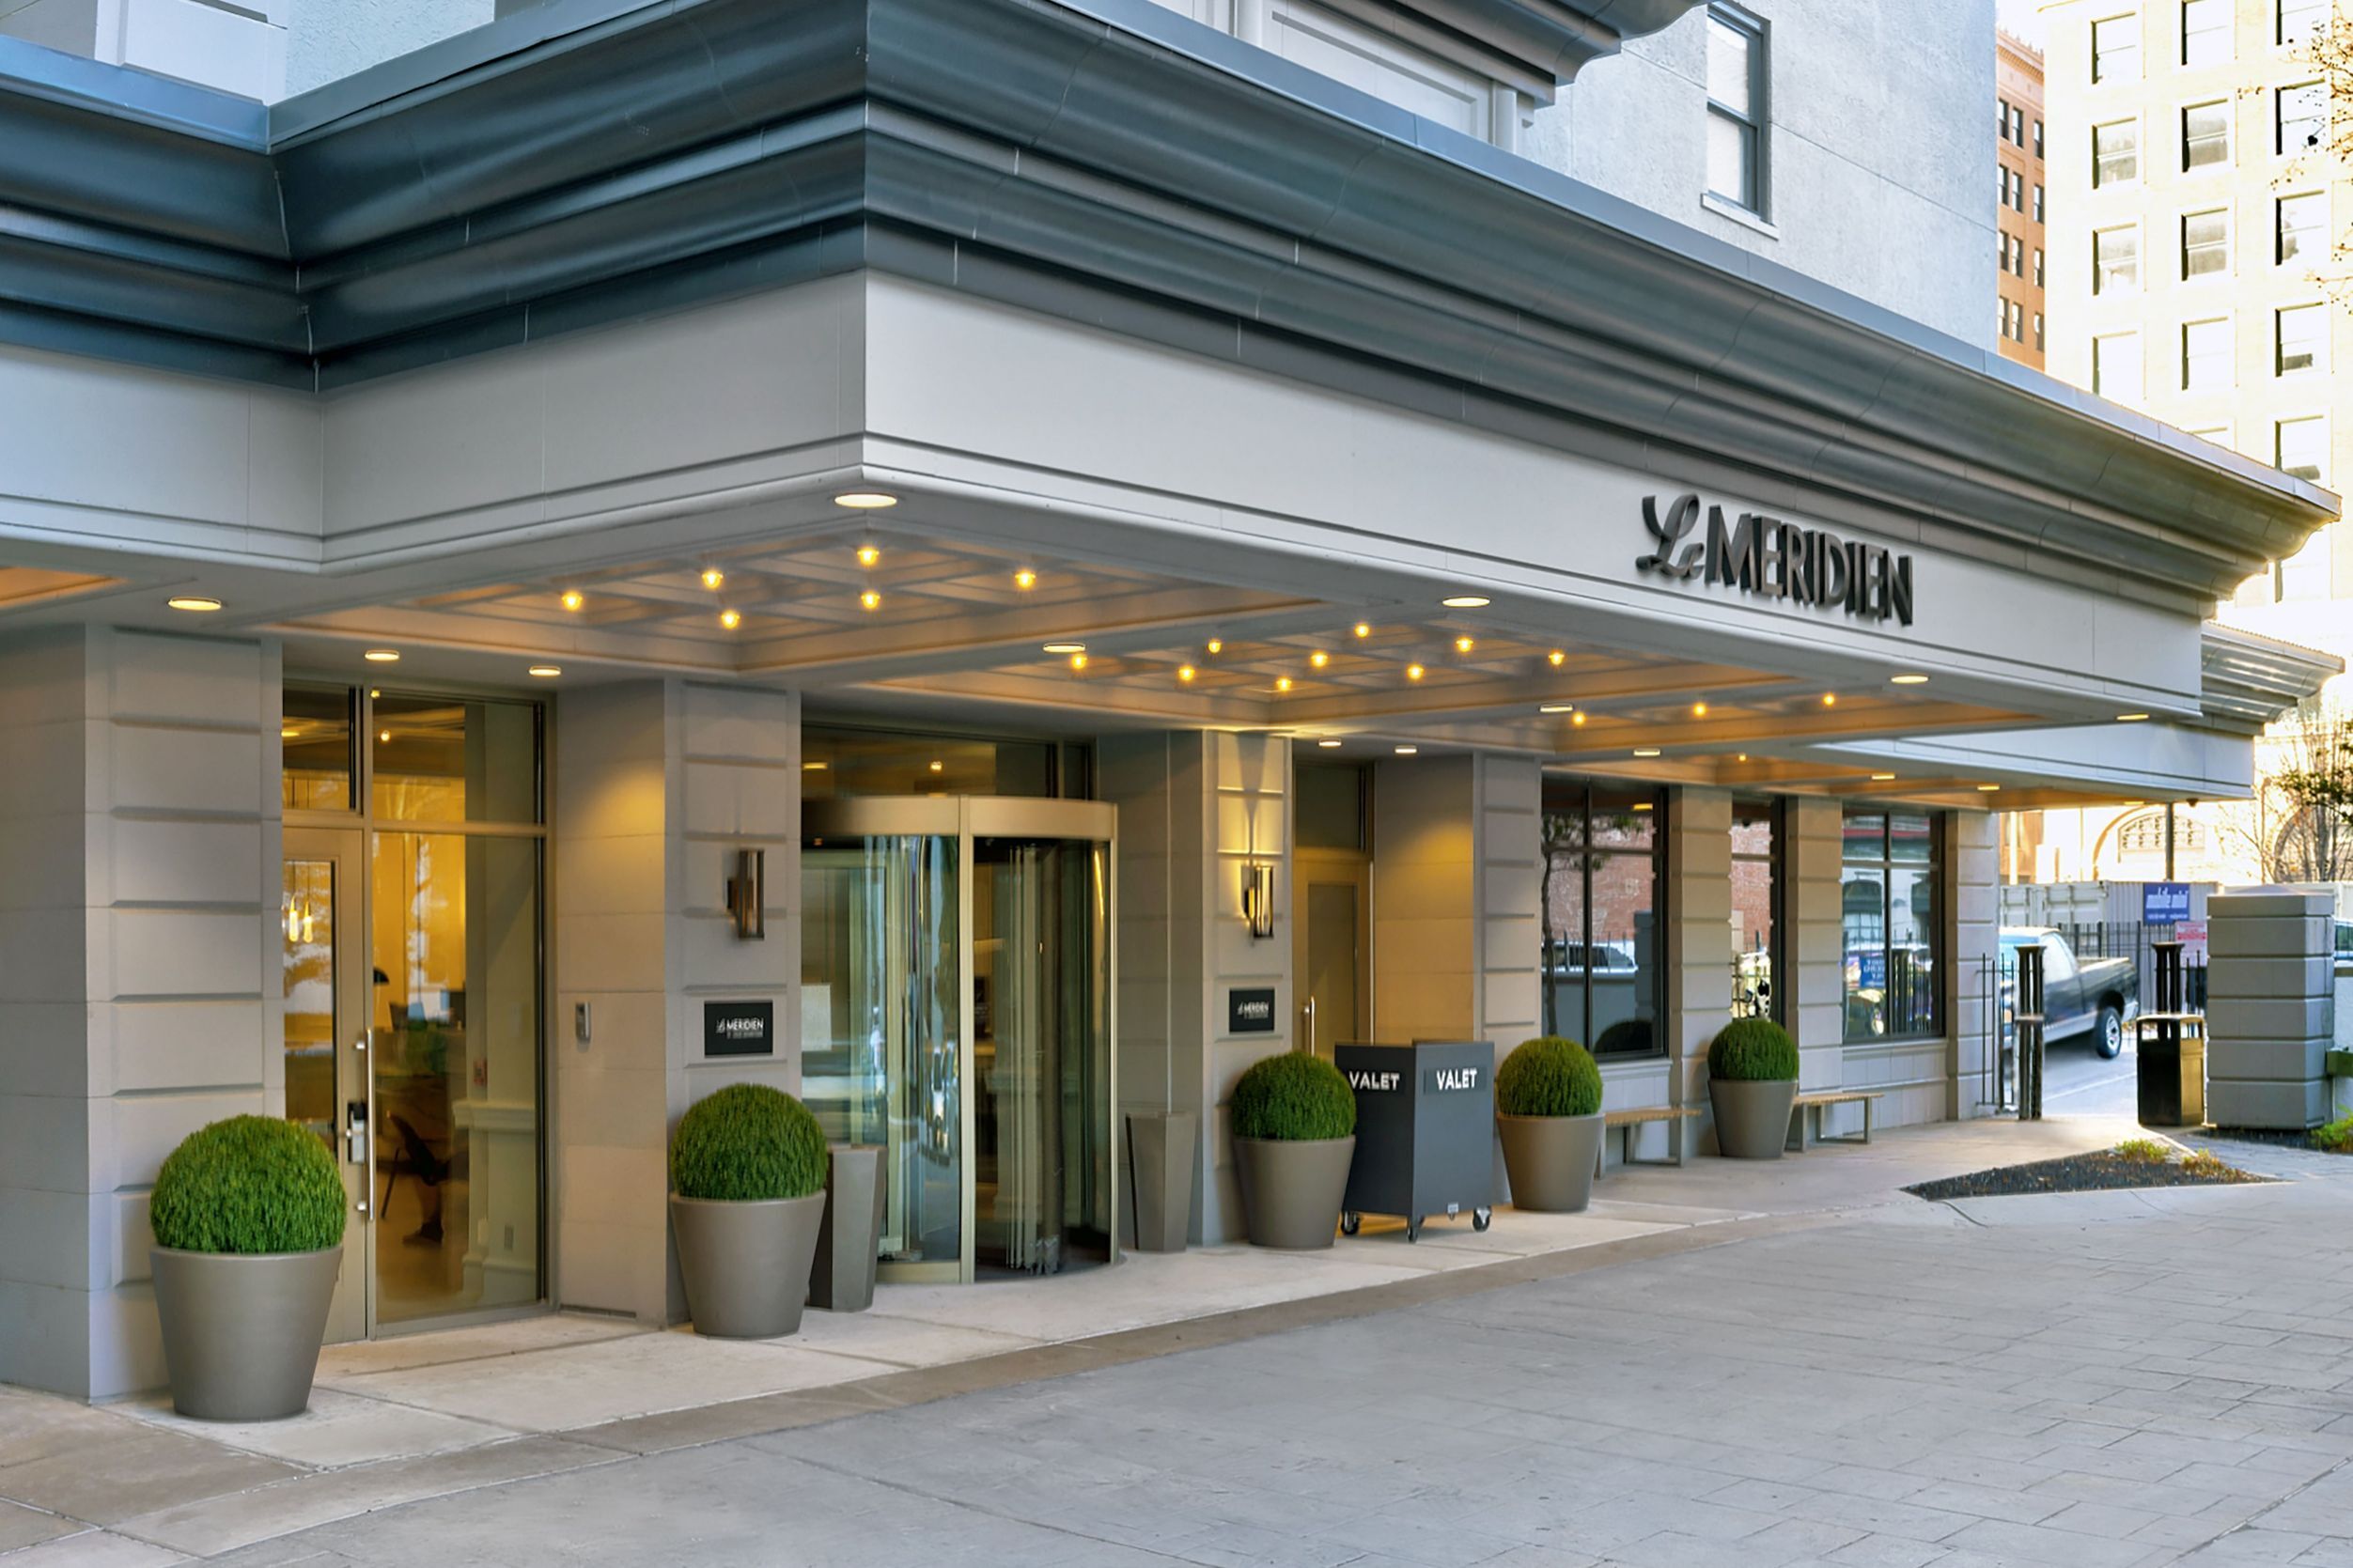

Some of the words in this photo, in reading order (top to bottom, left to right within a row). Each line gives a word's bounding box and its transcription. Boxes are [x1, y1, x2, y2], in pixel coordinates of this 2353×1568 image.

[1635, 493, 1705, 581] Le
[1704, 504, 1914, 627] MERIDIEN
[1348, 1070, 1400, 1091] VALET
[1435, 1067, 1478, 1091] VALET
